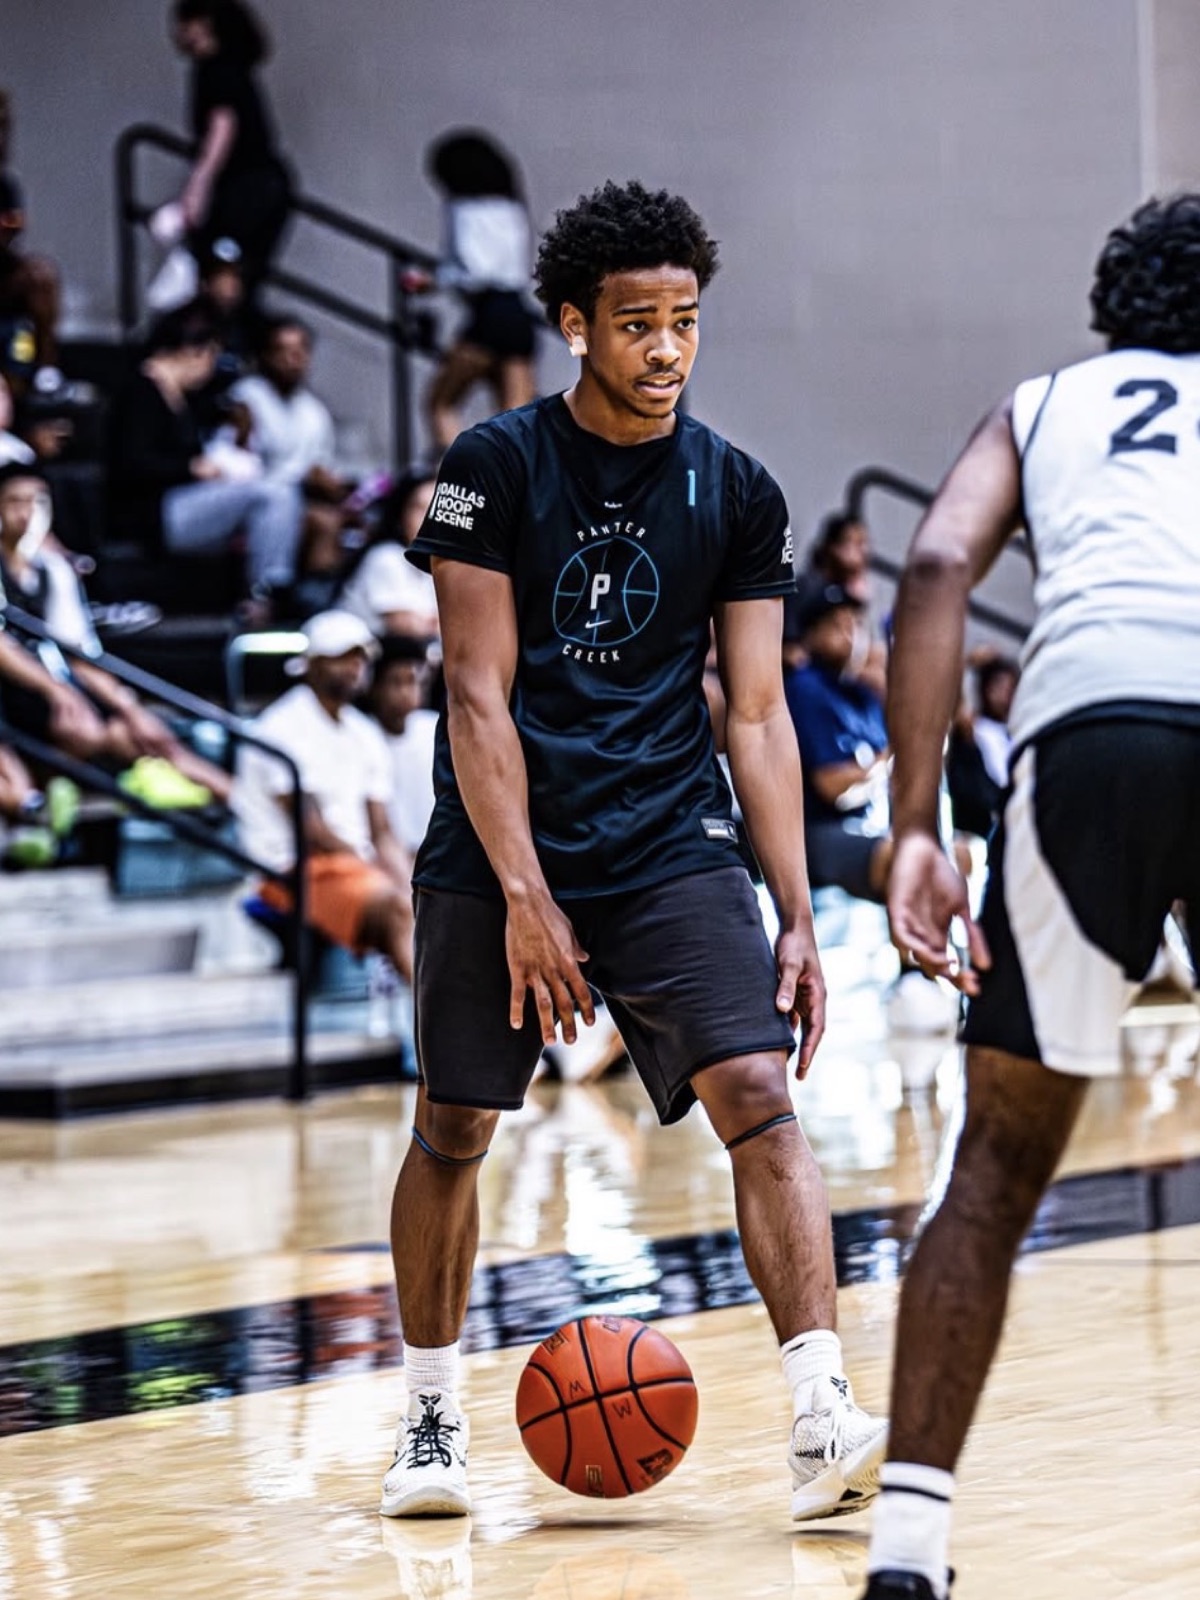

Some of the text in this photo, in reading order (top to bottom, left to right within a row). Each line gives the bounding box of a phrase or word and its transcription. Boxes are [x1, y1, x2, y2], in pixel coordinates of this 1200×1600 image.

[1108, 378, 1200, 456] 2
[437, 482, 486, 509] DALLAS
[687, 469, 696, 506] 1
[437, 496, 473, 515] HOOP
[434, 509, 474, 530] SCENE
[576, 521, 647, 542] PANTER
[590, 573, 611, 611] P
[562, 644, 621, 664] CREEK
